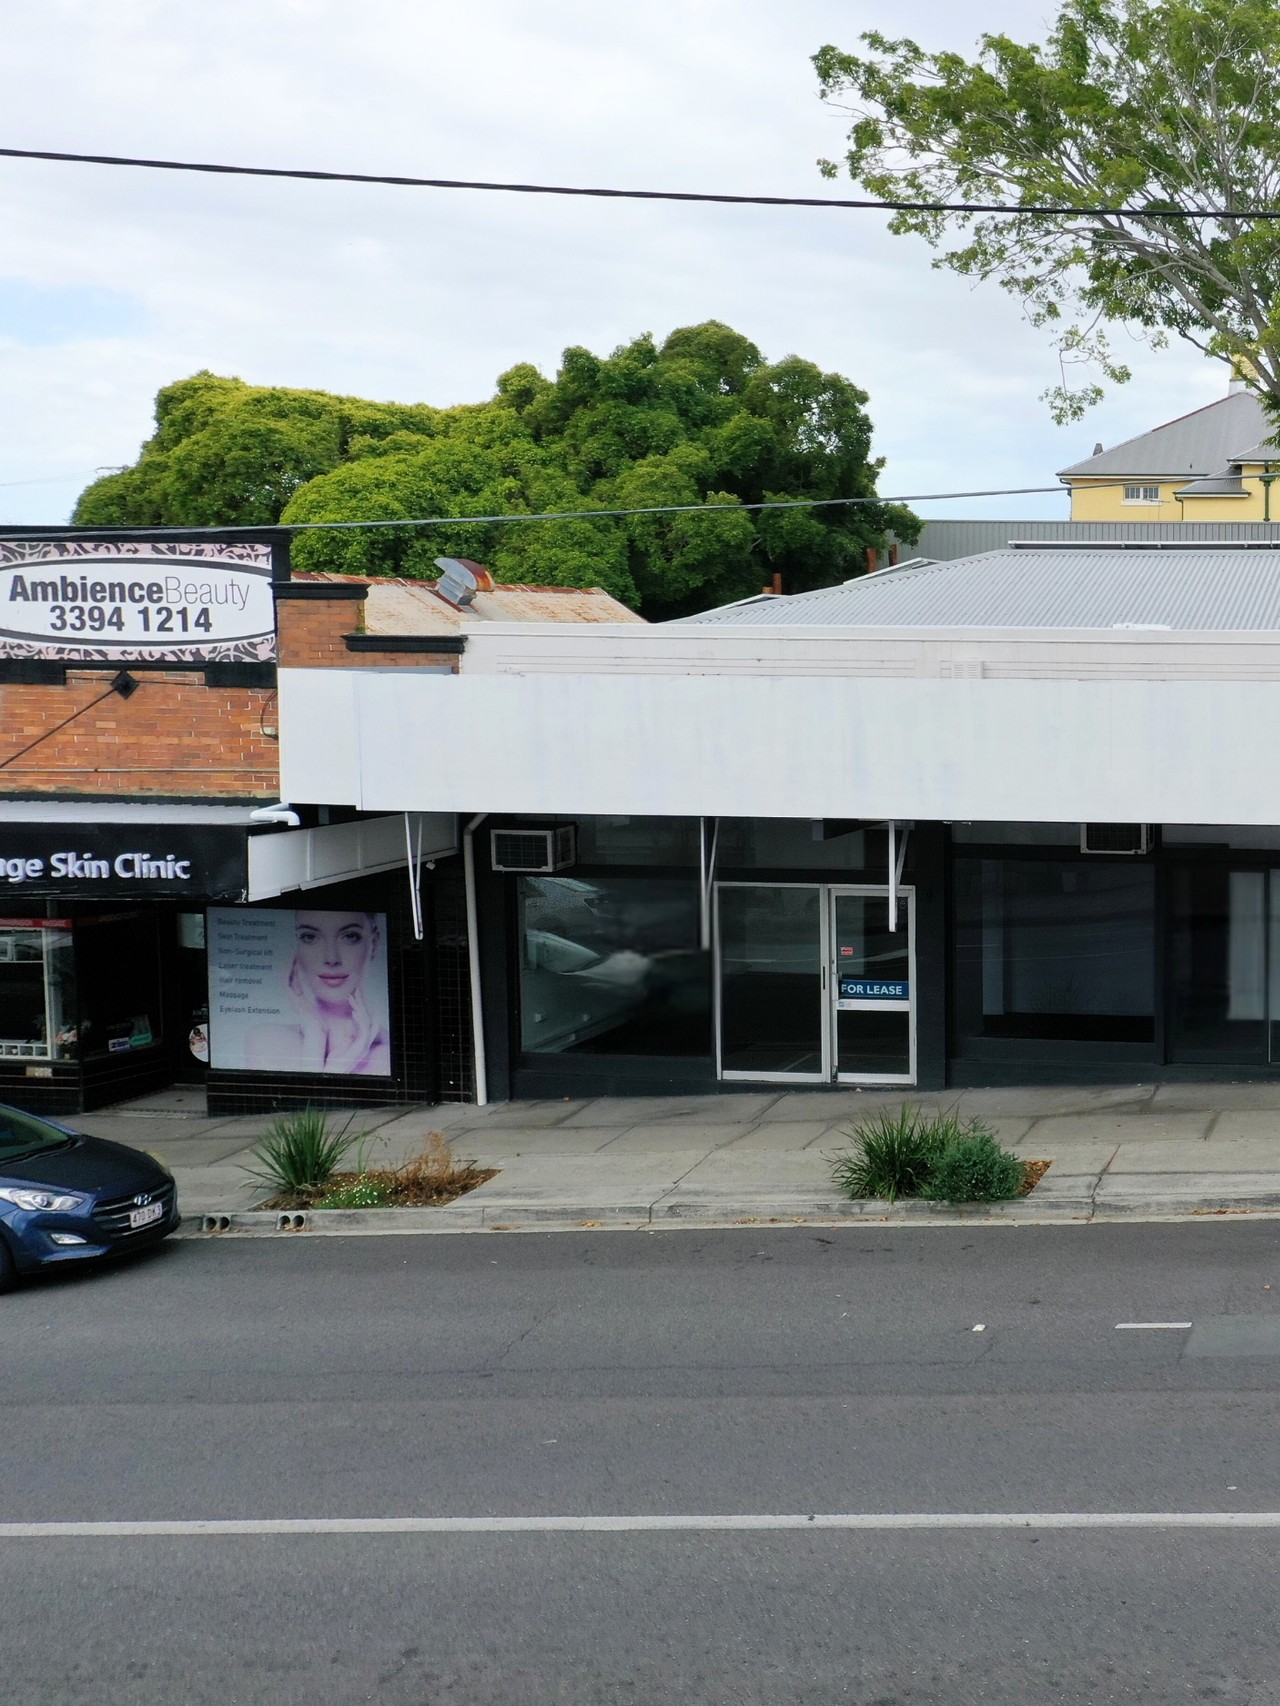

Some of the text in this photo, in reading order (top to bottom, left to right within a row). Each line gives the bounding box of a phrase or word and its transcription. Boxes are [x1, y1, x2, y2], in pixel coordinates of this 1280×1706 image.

[50, 605, 213, 633] 3394 1214
[50, 852, 110, 879] Skin
[114, 852, 191, 879] Clinic
[241, 919, 276, 927] Treatment
[841, 984, 903, 995] FOR LEASE
[219, 991, 249, 1000] Massage
[220, 1005, 280, 1015] Eyelash Extension
